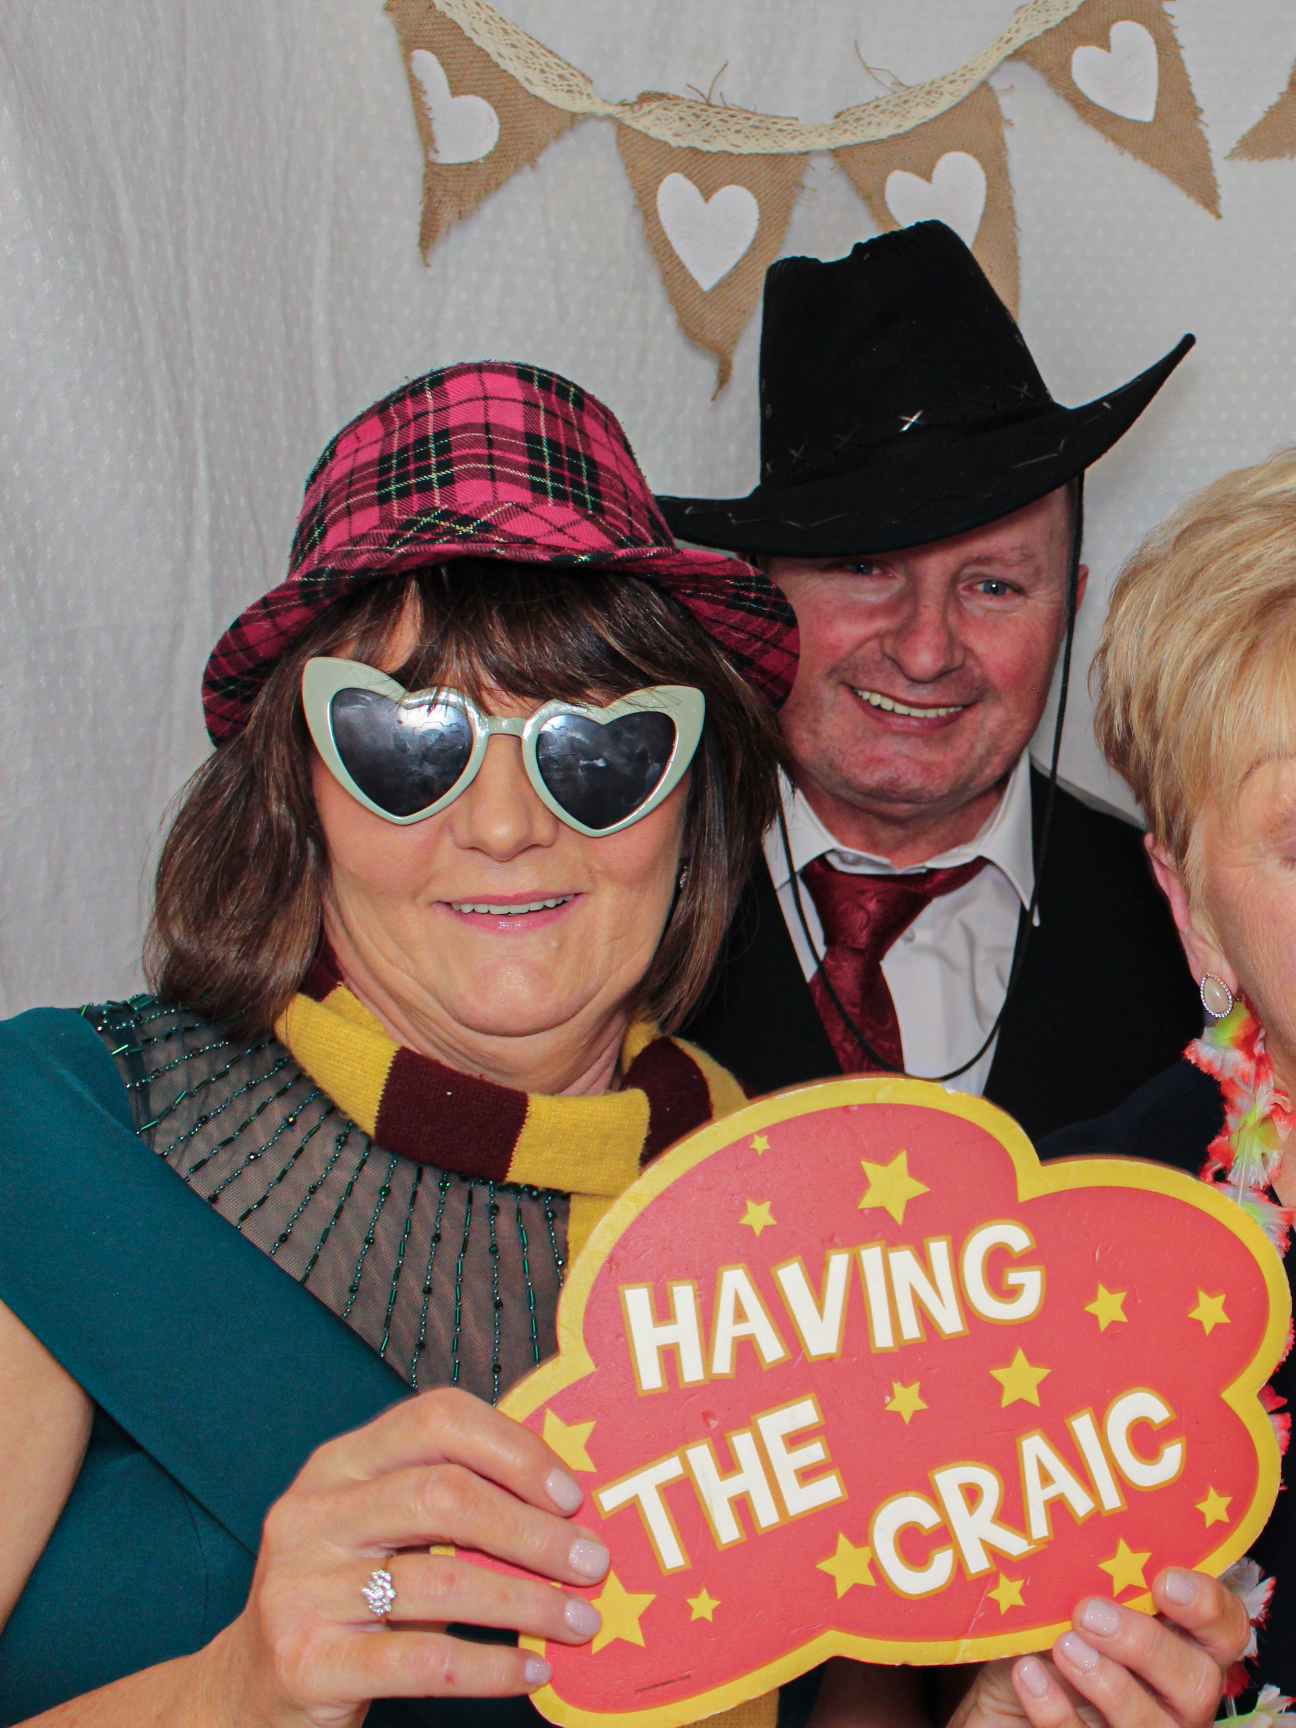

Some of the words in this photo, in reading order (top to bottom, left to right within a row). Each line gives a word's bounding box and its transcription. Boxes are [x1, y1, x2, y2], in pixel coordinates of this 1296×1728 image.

[622, 1223, 1043, 1392] HAVING
[596, 1397, 844, 1571] THE
[872, 1390, 1183, 1596] CRAIC
